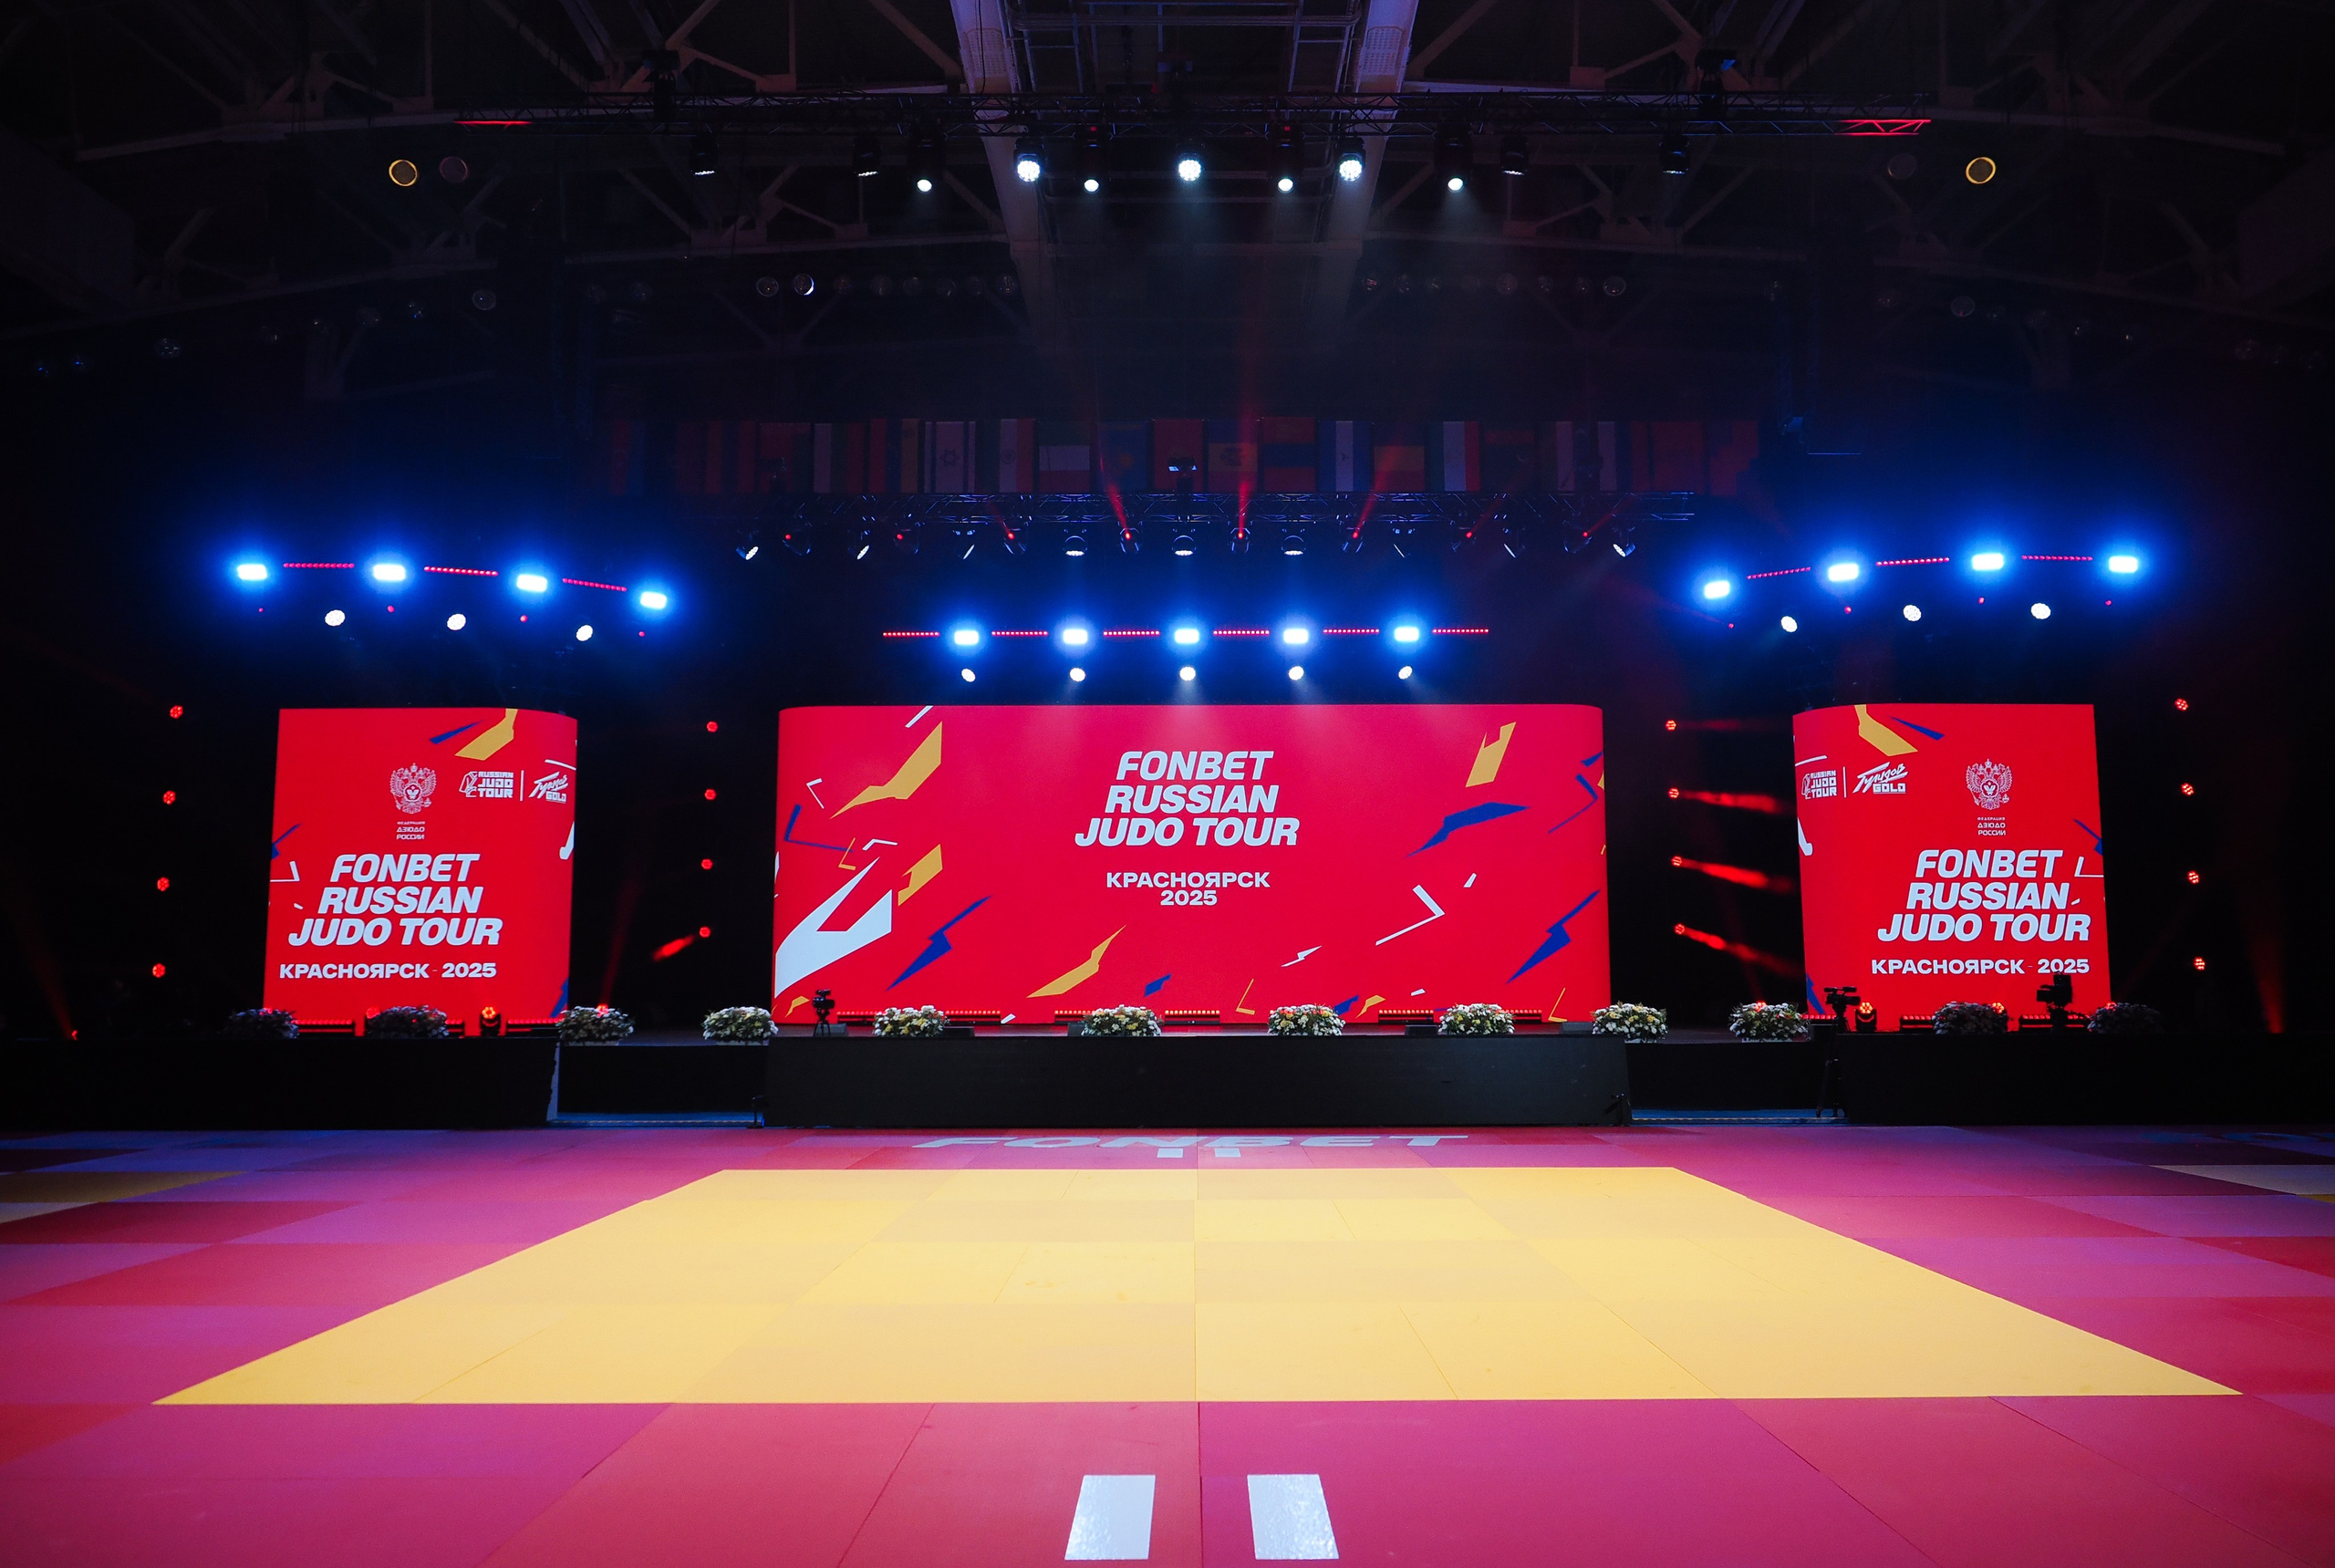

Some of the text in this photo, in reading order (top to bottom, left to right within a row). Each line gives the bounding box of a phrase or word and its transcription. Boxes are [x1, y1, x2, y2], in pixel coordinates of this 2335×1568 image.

[1116, 751, 1274, 781] FONBET
[1810, 770, 1836, 778] RUSSIAN
[478, 778, 514, 788] JUDO
[1811, 777, 1837, 788] JUDO
[1873, 783, 1906, 794] GOLD
[478, 788, 513, 798] TOUR
[545, 791, 566, 803] GOLD
[1105, 784, 1279, 814] RUSSIAN
[1811, 786, 1837, 798] TOUR
[1074, 817, 1300, 846] JUDO TOUR
[330, 854, 480, 882] FONBET
[1915, 849, 2063, 877] FONBET
[1106, 872, 1271, 888] КРАСНОЯРСК
[317, 886, 483, 914] RUSSIAN
[1160, 890, 1218, 906] 2025
[1906, 882, 2070, 909] RUSSIAN
[288, 918, 503, 946] JUDO TOUR
[1878, 913, 2091, 941] JUDO TOUR
[280, 963, 430, 979] КРАСНОЯРСК
[441, 962, 497, 978] 2025
[1872, 960, 2026, 974] КРАСНОЯРСК
[2038, 959, 2090, 974] 2025
[912, 1135, 1468, 1147] FONBET
